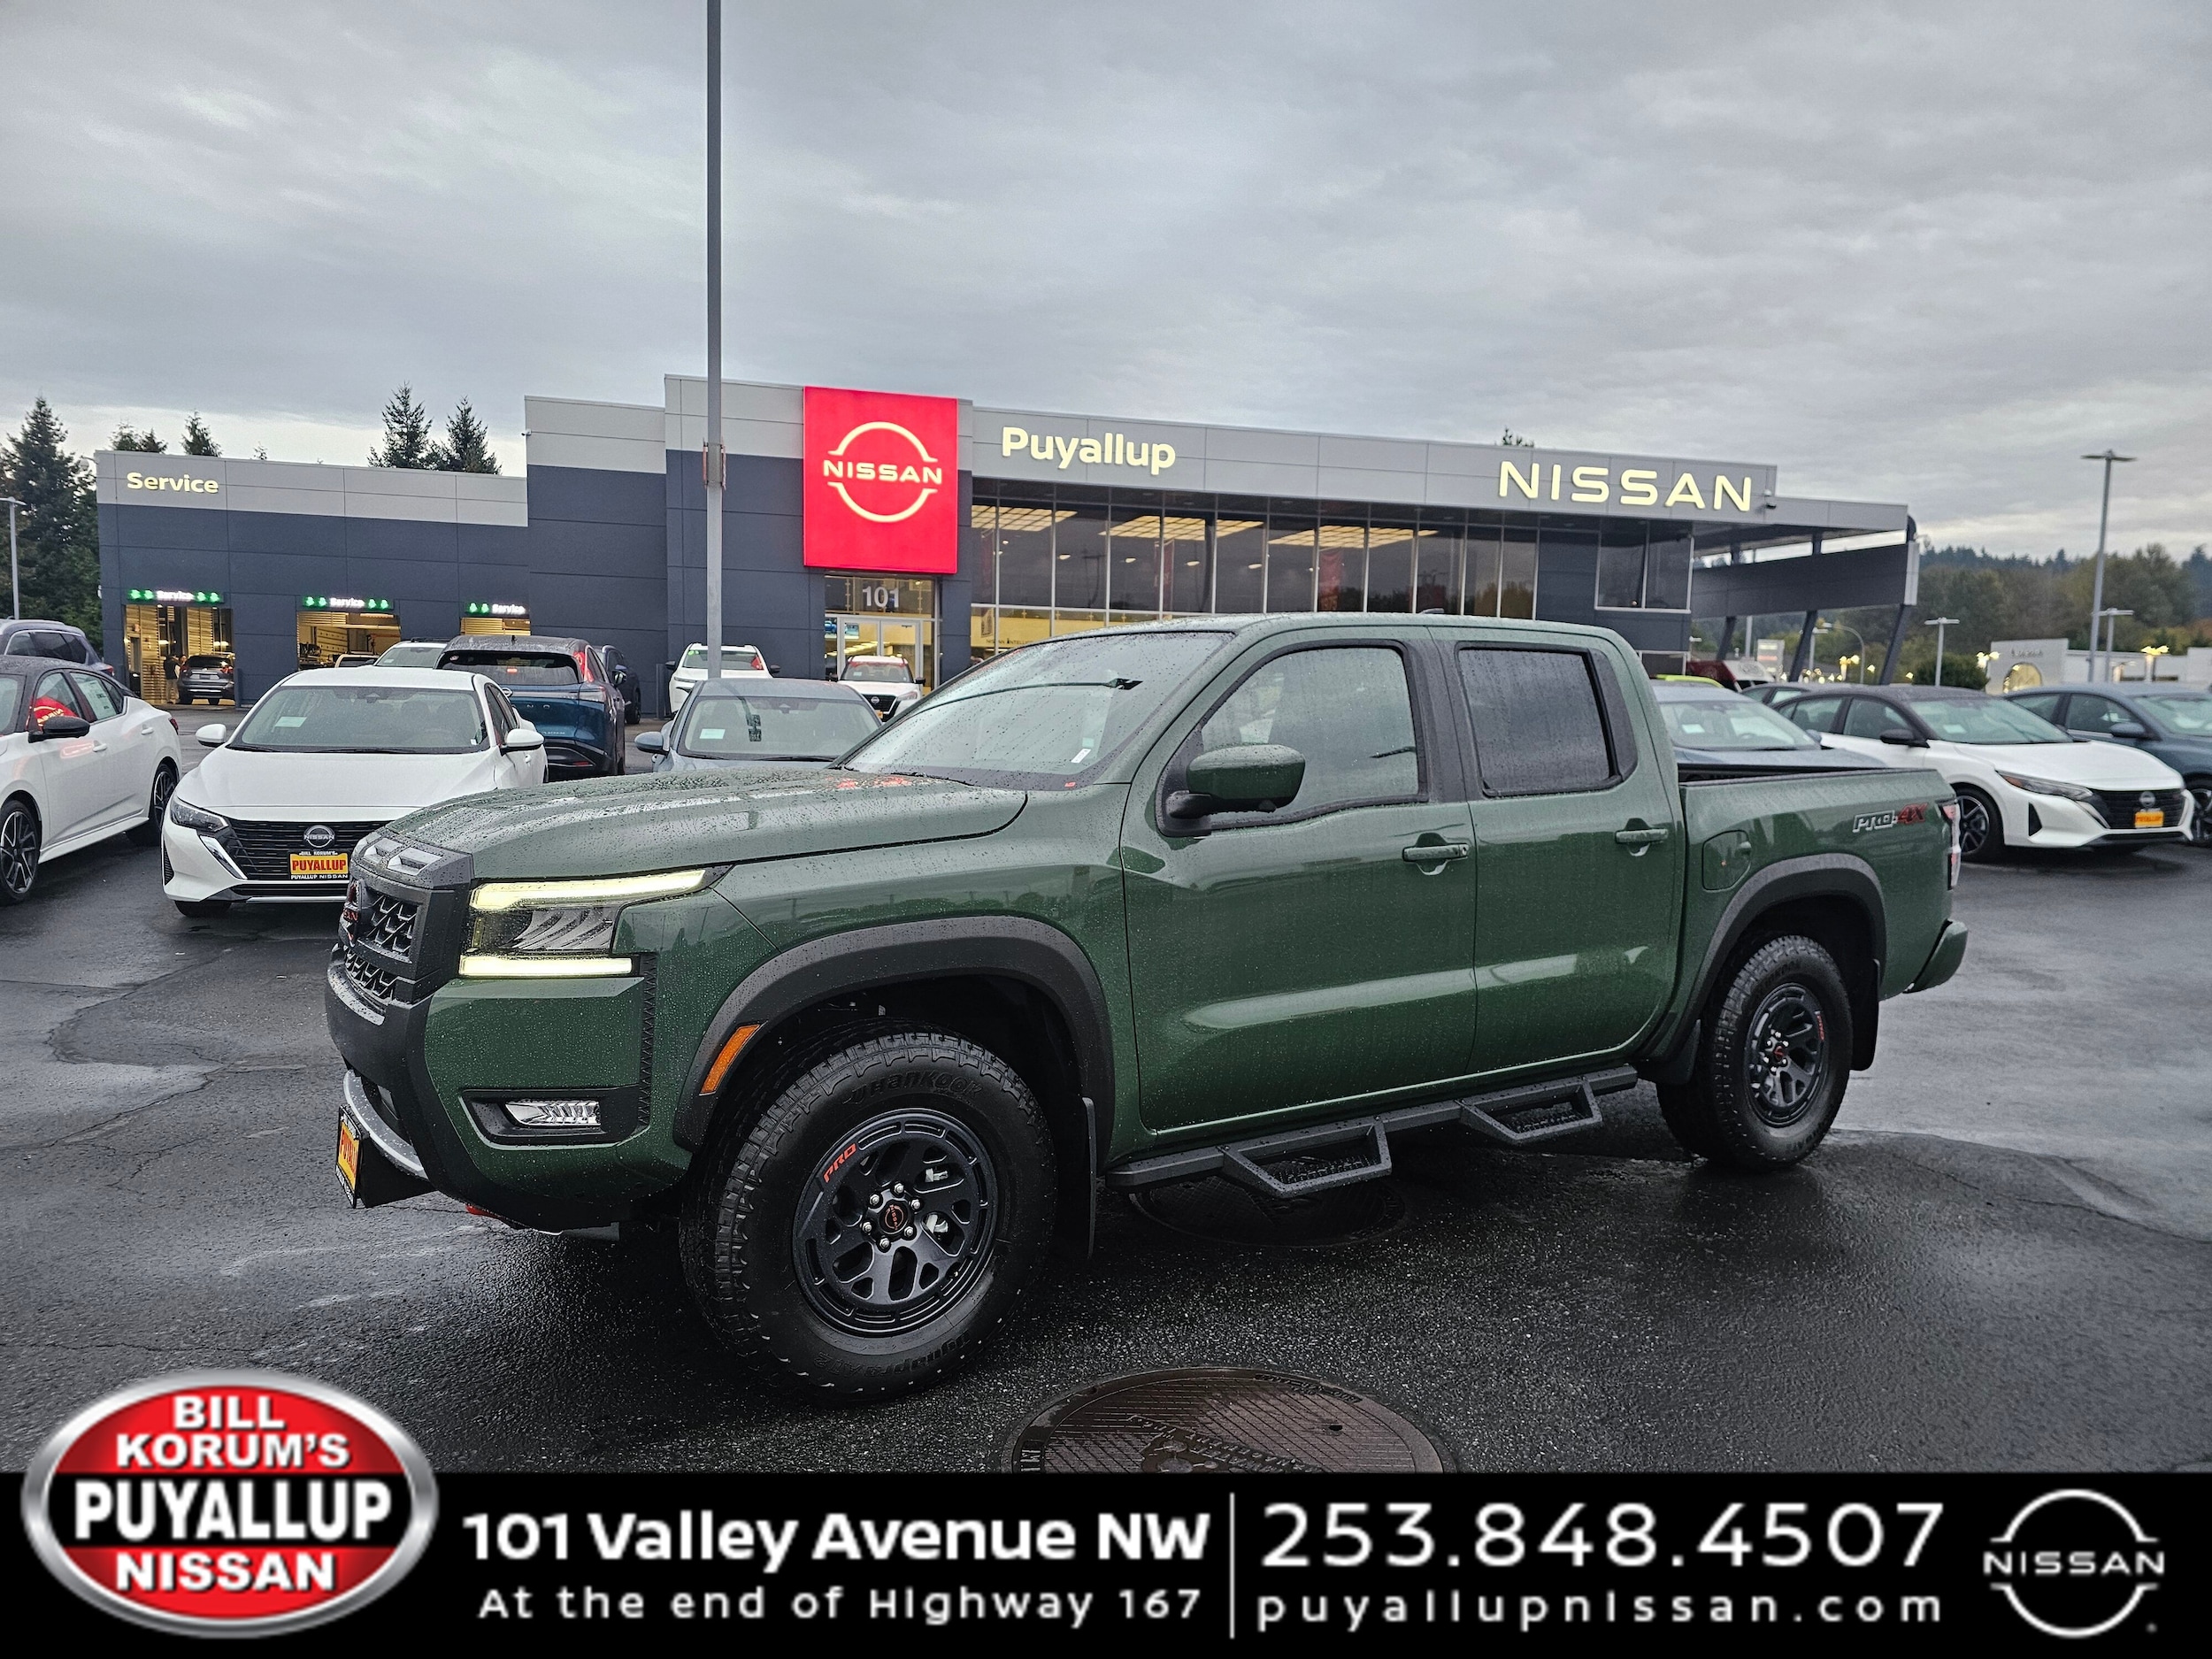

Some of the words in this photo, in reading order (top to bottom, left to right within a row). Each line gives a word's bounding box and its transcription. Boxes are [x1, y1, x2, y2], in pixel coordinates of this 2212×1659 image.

[1002, 426, 1176, 475] Puyallup
[127, 472, 219, 494] Service
[823, 459, 942, 485] NISSAN
[1499, 460, 1752, 511] NISSAN
[329, 597, 365, 608] Service
[863, 586, 900, 608] 101
[492, 603, 526, 614] Service
[292, 859, 346, 871] PUYALLUP
[823, 1143, 857, 1183] PRO
